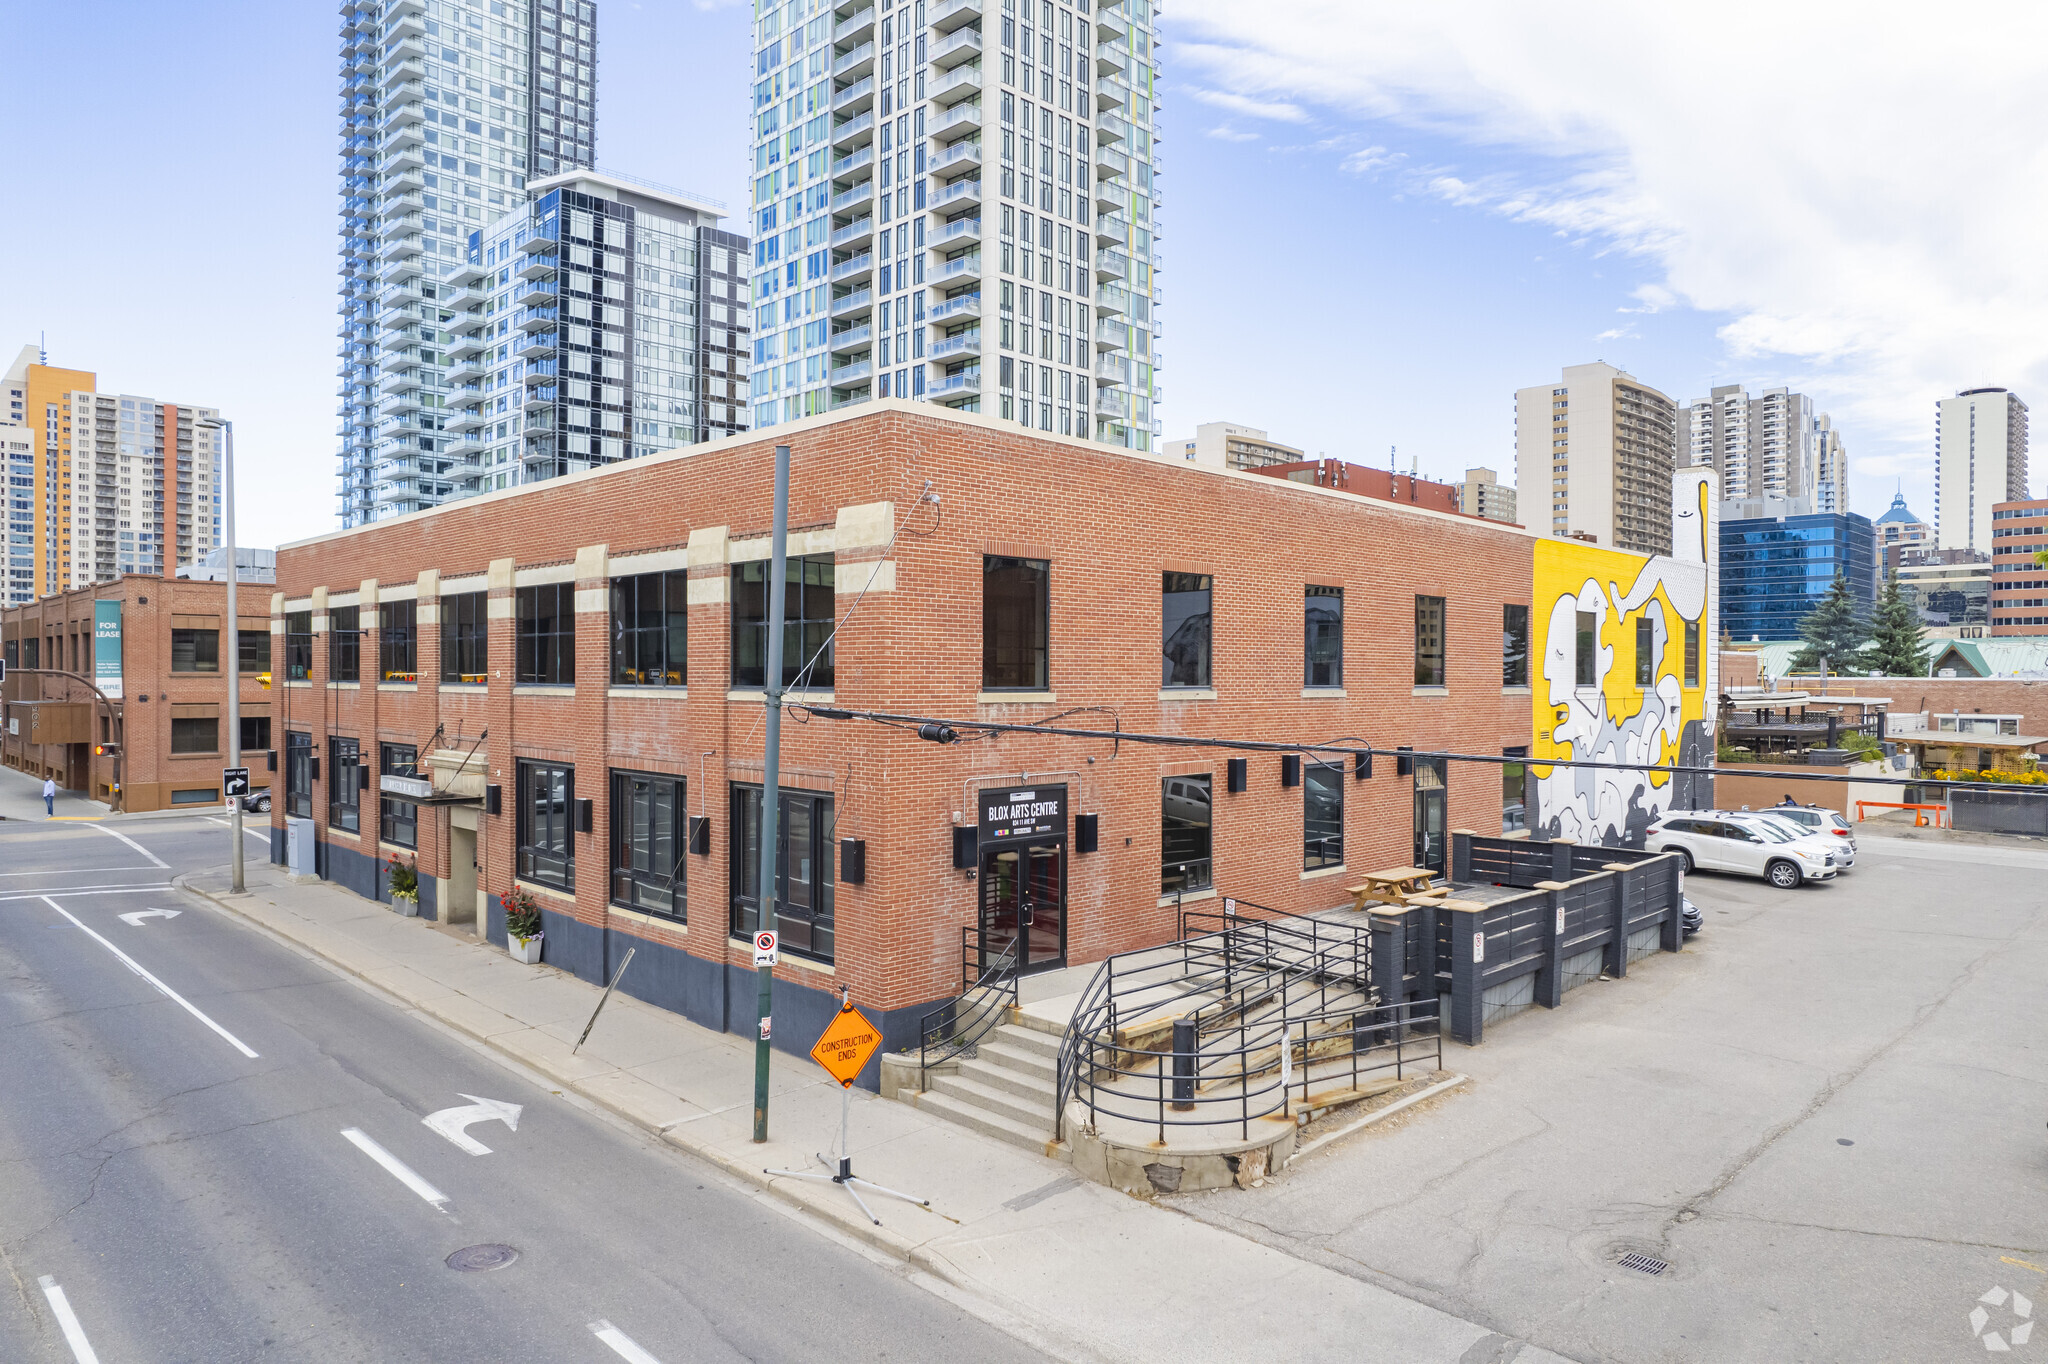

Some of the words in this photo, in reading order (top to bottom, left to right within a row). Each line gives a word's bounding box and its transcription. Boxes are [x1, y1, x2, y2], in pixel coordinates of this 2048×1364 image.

[95, 630, 120, 638] LEASE
[989, 806, 1009, 821] BLOX
[1010, 804, 1029, 819] ARTS
[1031, 801, 1058, 817] CENTRE
[821, 1033, 873, 1053] CONSTRUCTION
[838, 1048, 857, 1062] ENDS
